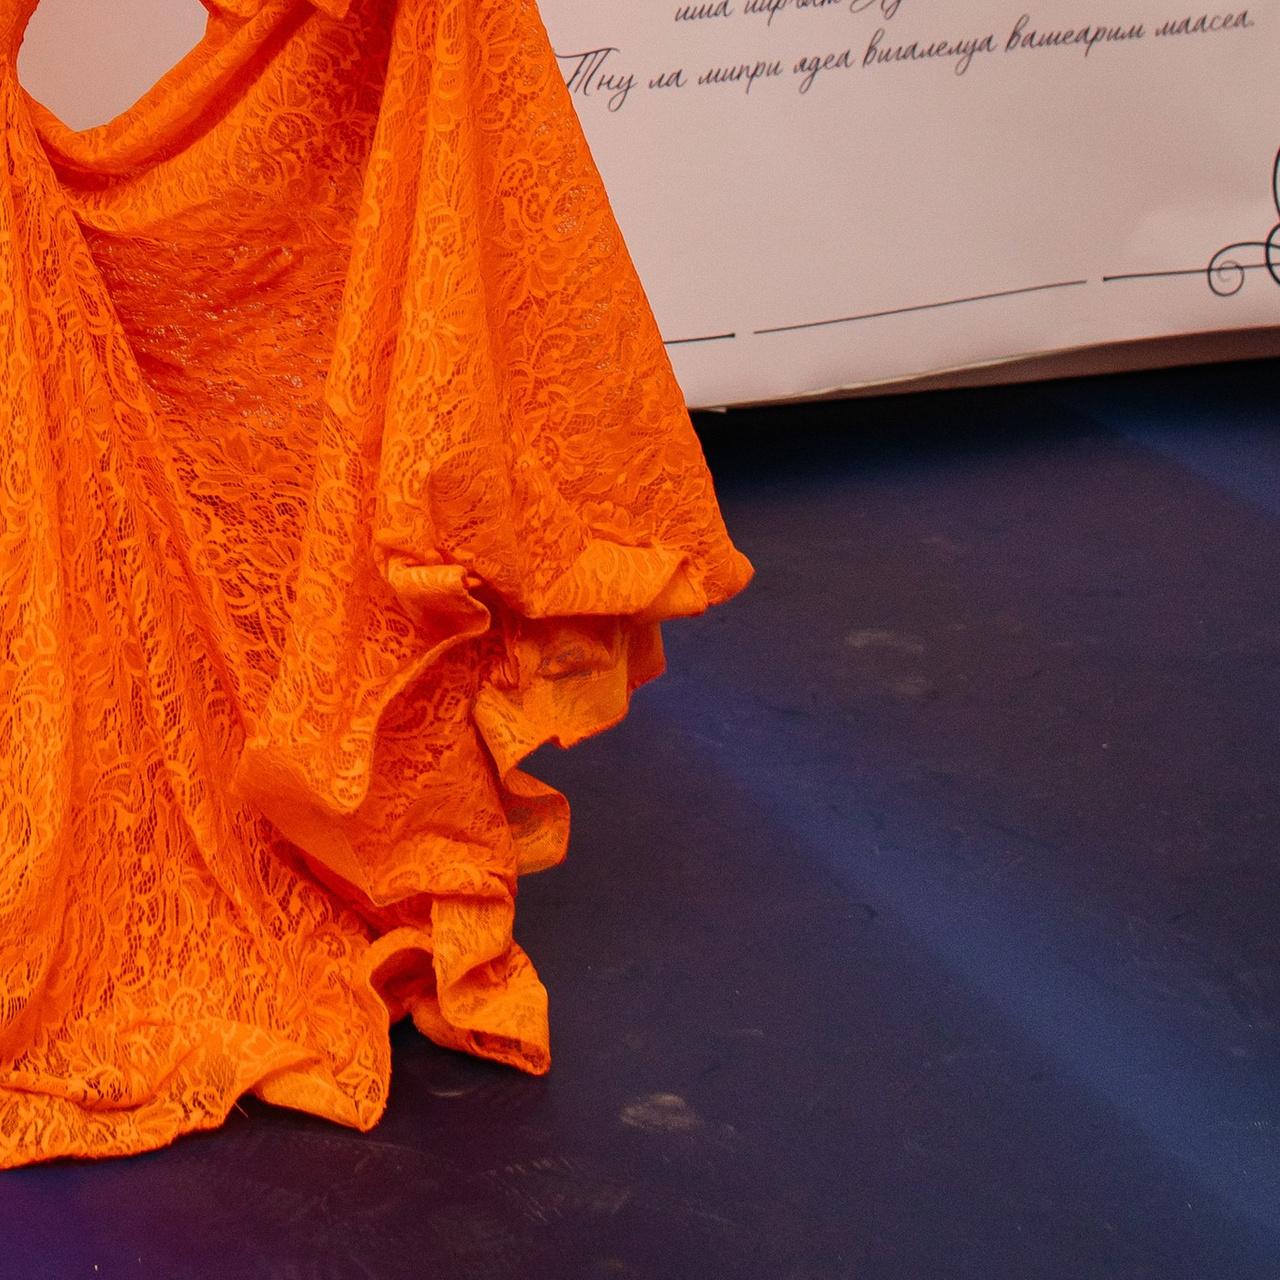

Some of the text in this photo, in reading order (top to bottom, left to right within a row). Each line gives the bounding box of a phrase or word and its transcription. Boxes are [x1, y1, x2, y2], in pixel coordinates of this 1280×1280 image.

[674, 0, 735, 22] иша
[698, 60, 783, 94] мипри
[794, 49, 855, 94] ядеа
[1005, 13, 1146, 58] вашеарим
